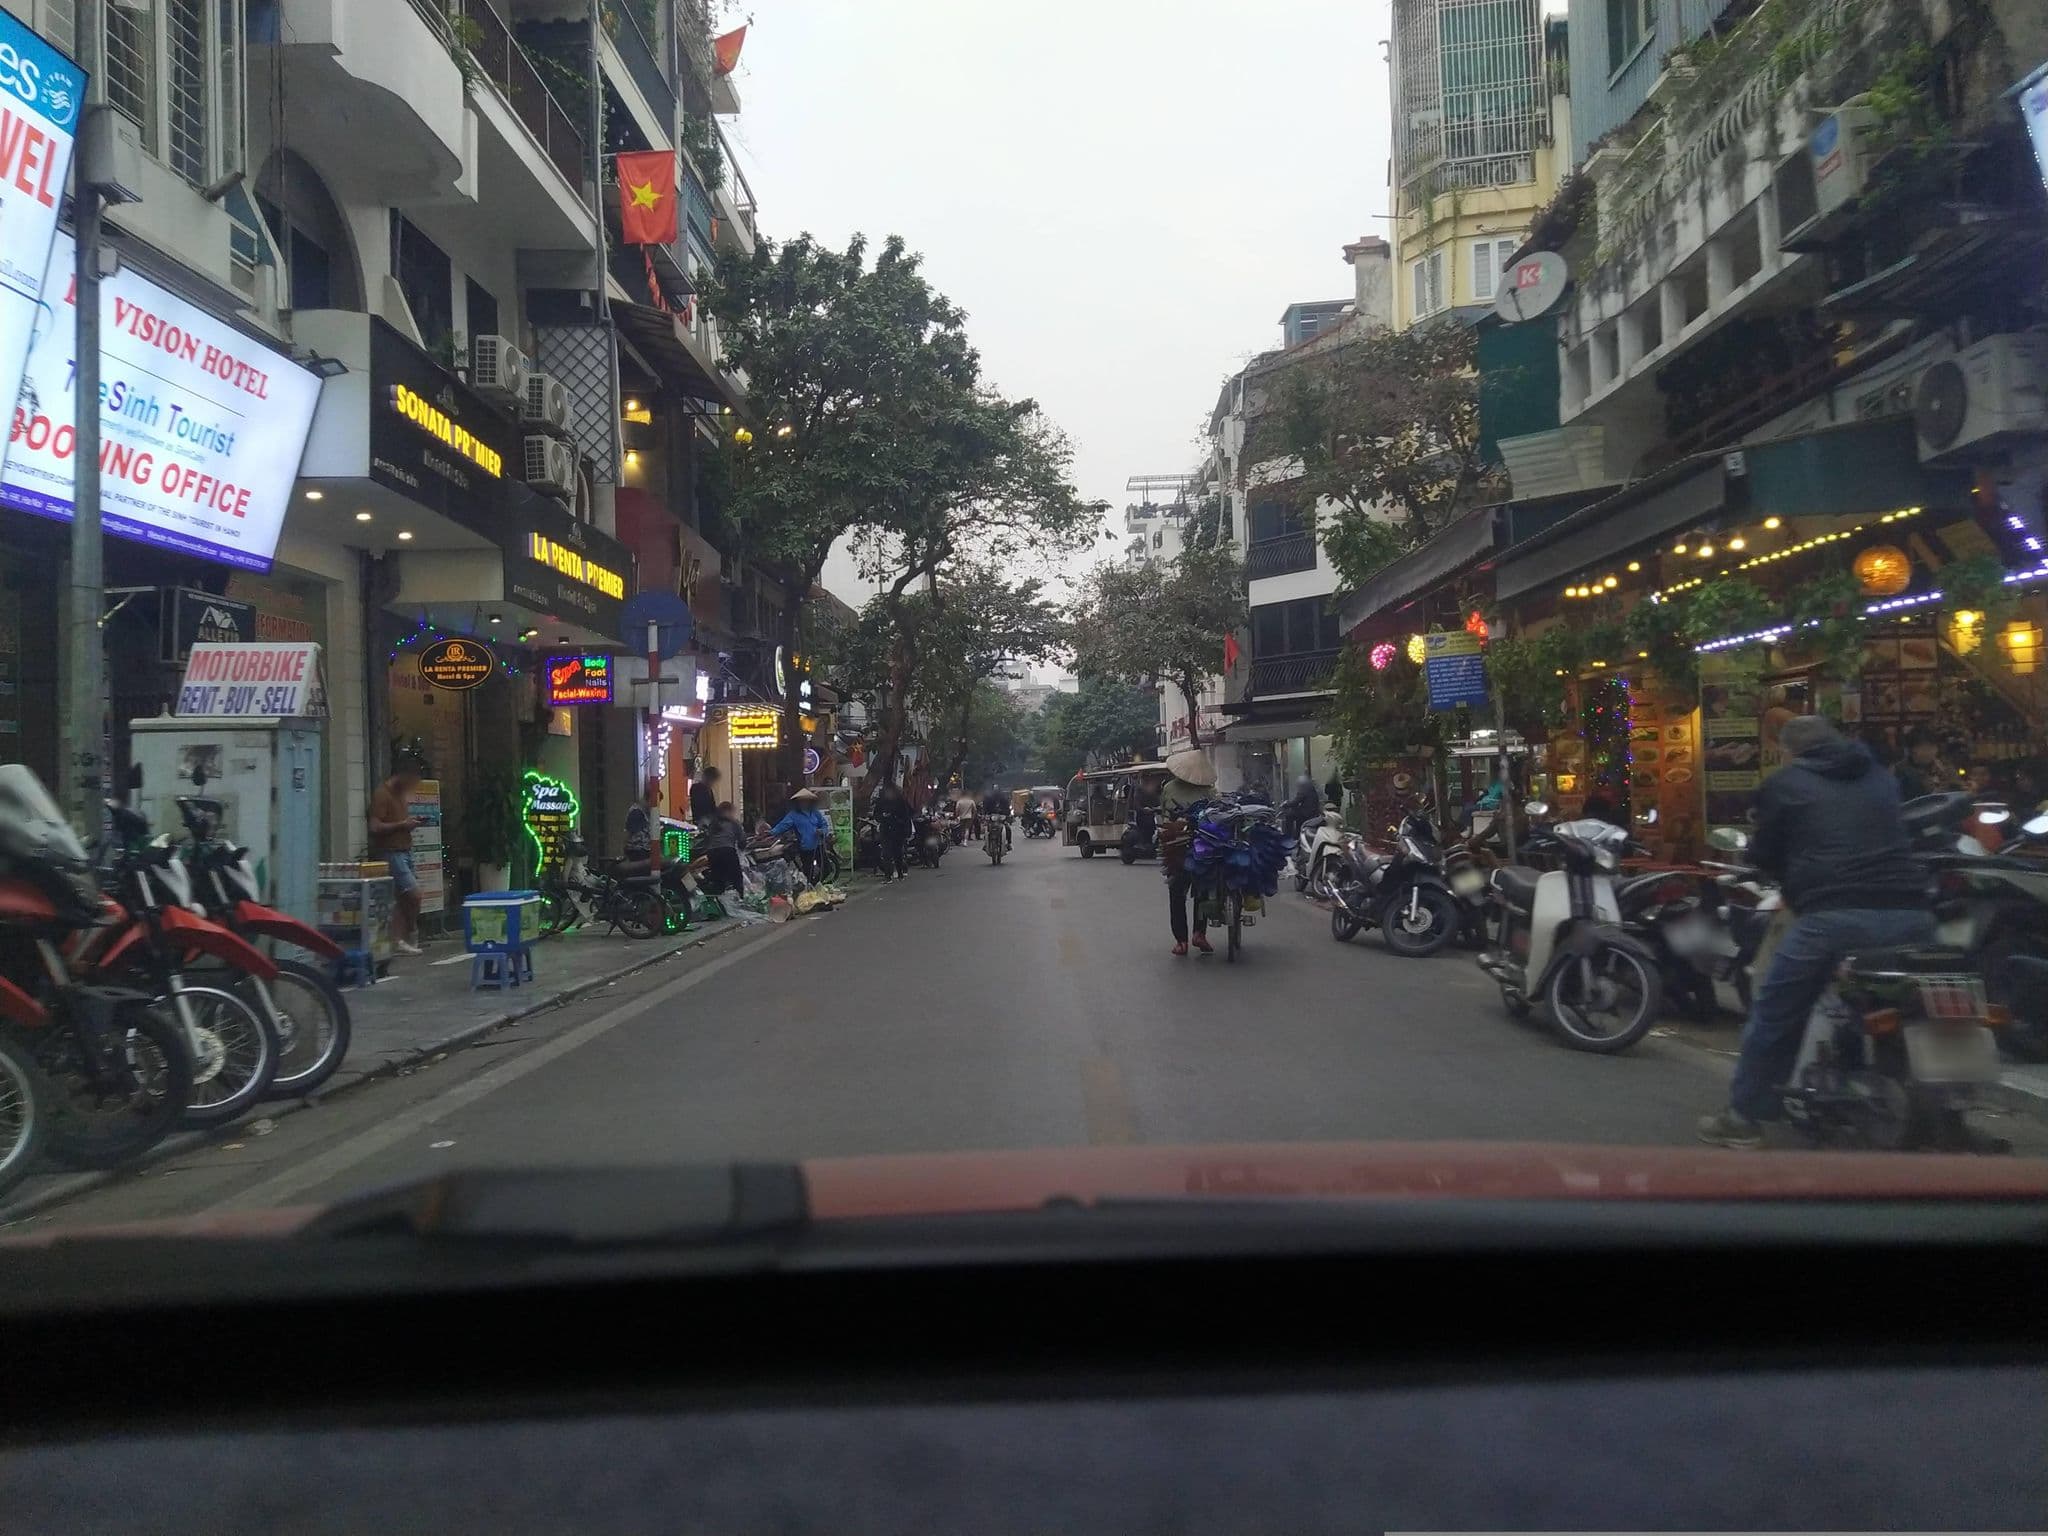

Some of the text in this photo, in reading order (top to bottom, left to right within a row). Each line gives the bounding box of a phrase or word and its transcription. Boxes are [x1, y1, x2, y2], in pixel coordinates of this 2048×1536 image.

[114, 297, 268, 400] VISION HOTEL
[166, 403, 236, 457] Tourist
[396, 384, 453, 445] SONATA
[9, 406, 153, 485] BOOING
[161, 463, 252, 518] OFFICE
[533, 532, 549, 565] LA
[187, 650, 308, 682] MOTORBIKE
[585, 668, 606, 677] Foot
[585, 678, 607, 687] Nails
[530, 800, 573, 813] Massage
[532, 784, 560, 799] Spa
